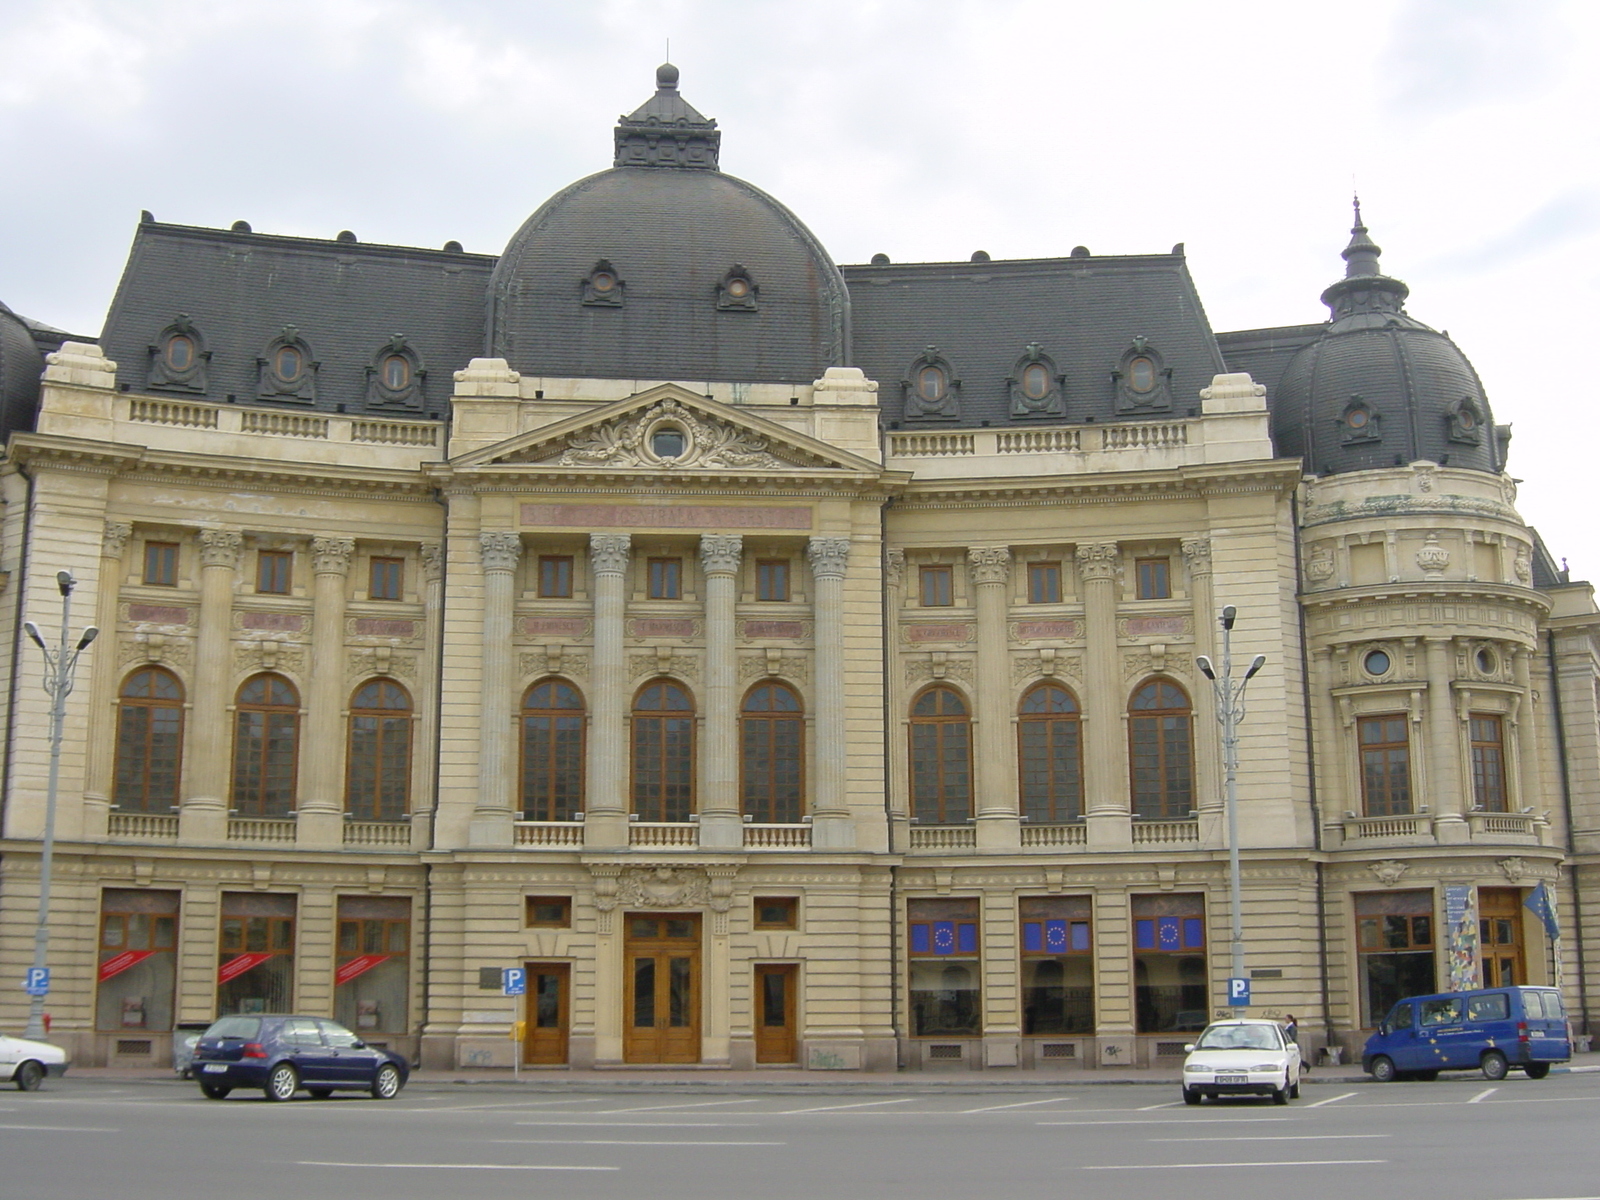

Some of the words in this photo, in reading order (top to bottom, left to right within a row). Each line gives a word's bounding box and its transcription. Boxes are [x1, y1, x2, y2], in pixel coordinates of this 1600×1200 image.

[32, 970, 45, 987] P
[509, 970, 521, 987] P
[1232, 979, 1246, 997] P
